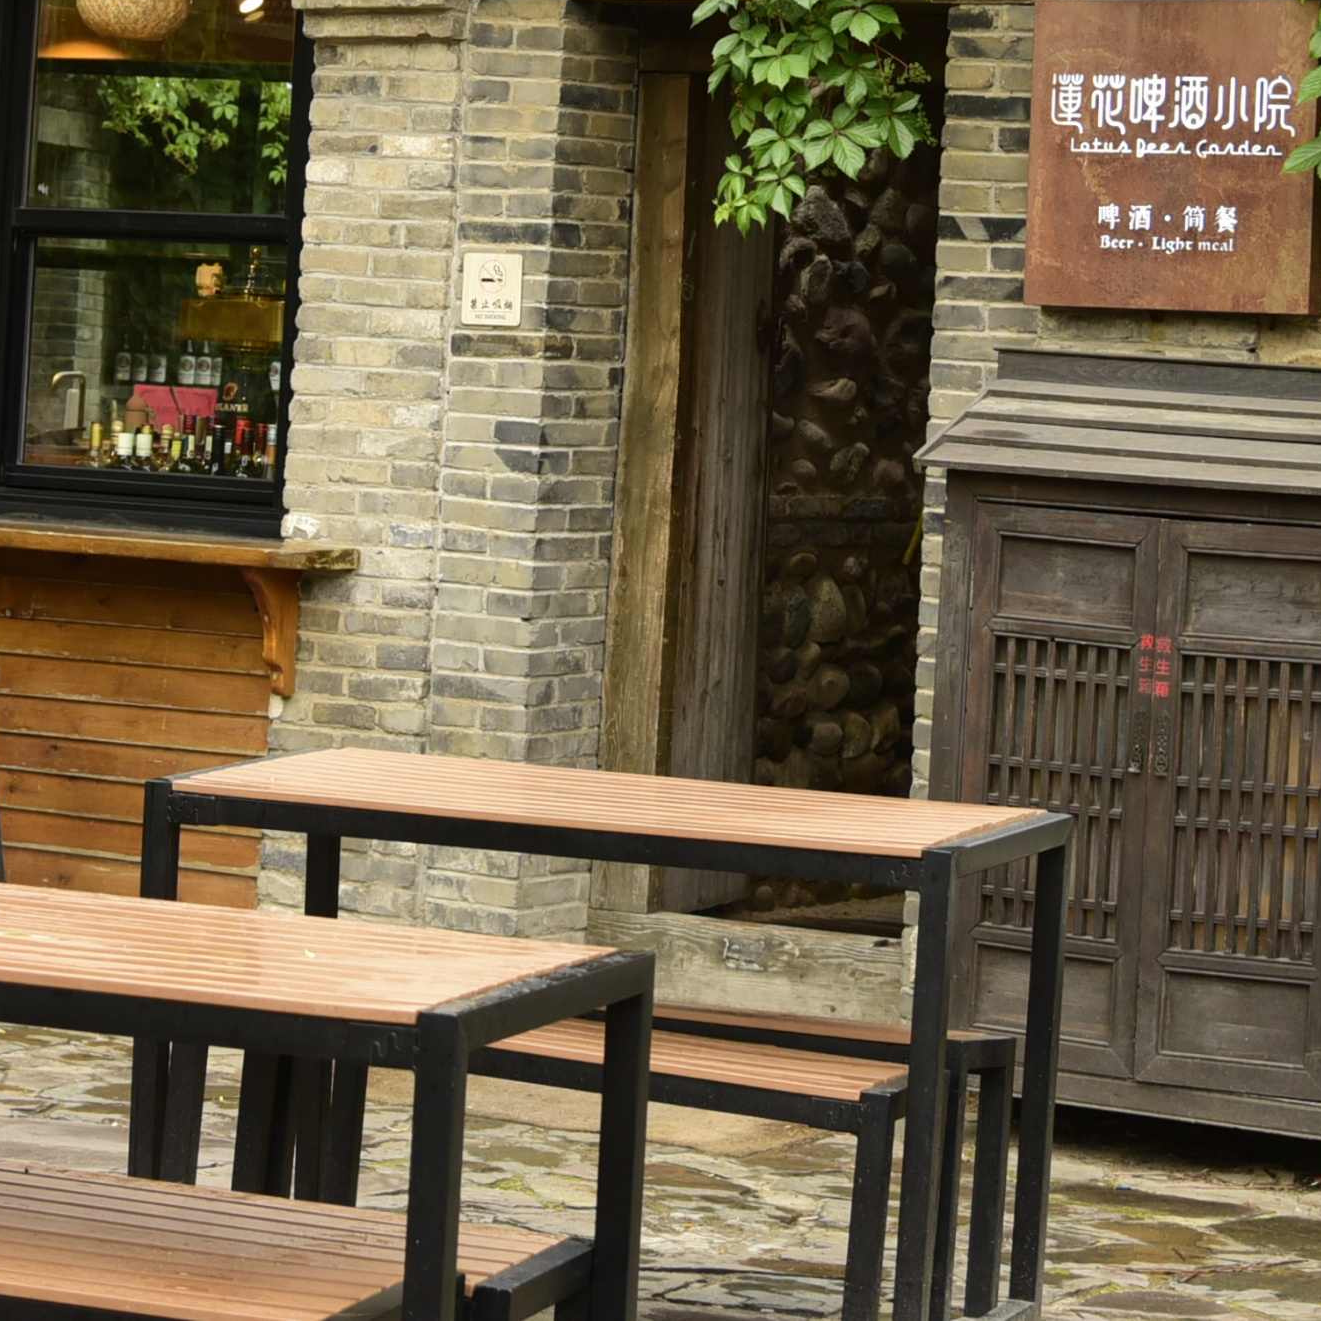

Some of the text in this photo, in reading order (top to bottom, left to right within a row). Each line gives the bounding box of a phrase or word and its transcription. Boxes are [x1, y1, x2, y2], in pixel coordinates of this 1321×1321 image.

[1070, 137, 1283, 158] Lotus Beer Garden
[1151, 235, 1194, 255] Light
[1197, 238, 1235, 252] meal
[1155, 636, 1172, 698] 救生箱
